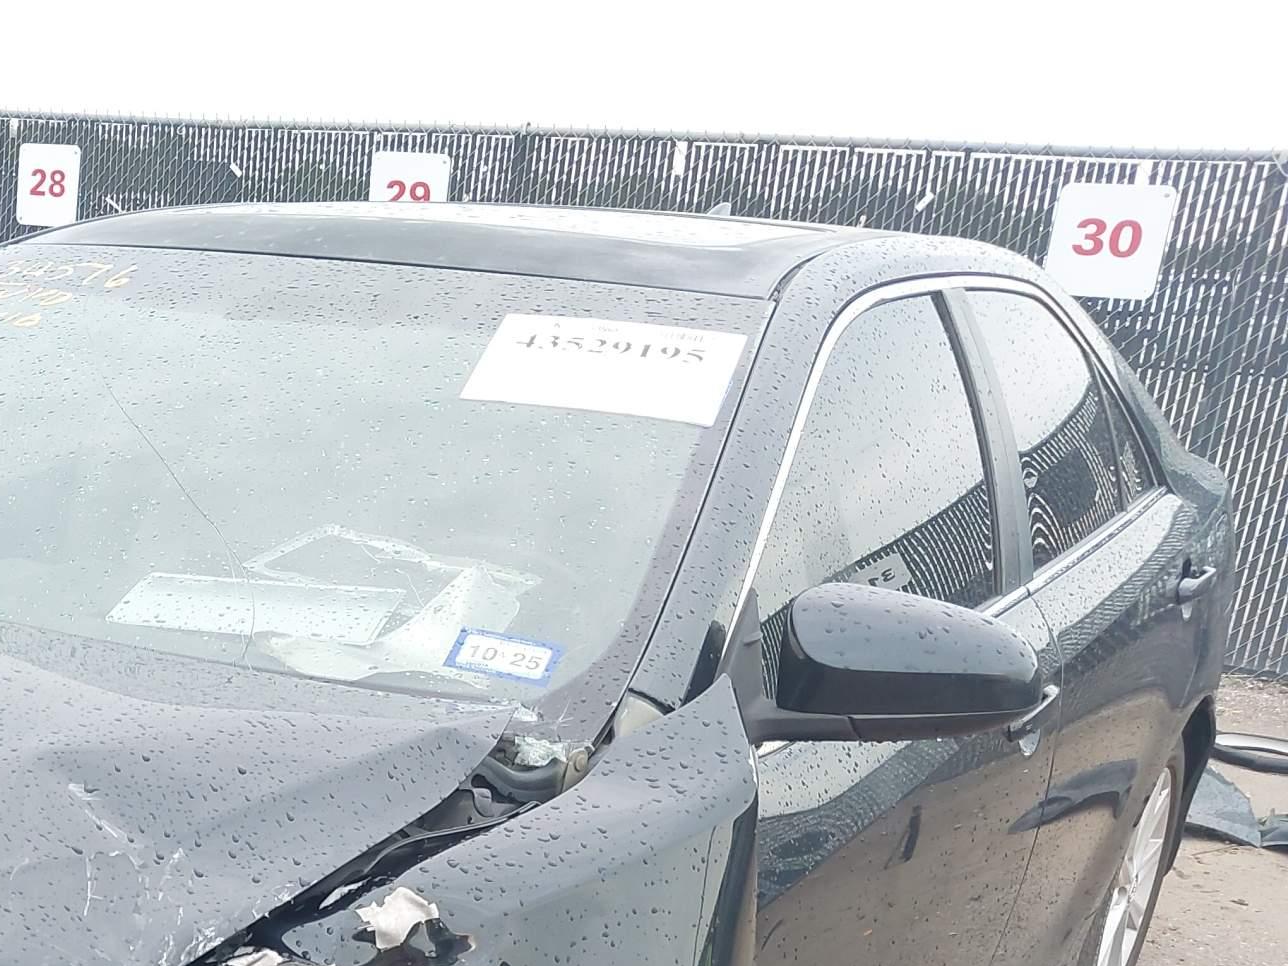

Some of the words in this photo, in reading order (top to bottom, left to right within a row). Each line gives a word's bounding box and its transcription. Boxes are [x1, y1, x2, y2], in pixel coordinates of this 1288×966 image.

[29, 168, 66, 198] 28
[386, 179, 431, 202] 29
[1071, 217, 1143, 258] 30
[516, 333, 707, 364] 43529195
[470, 645, 498, 661] 10
[510, 652, 543, 670] 25
